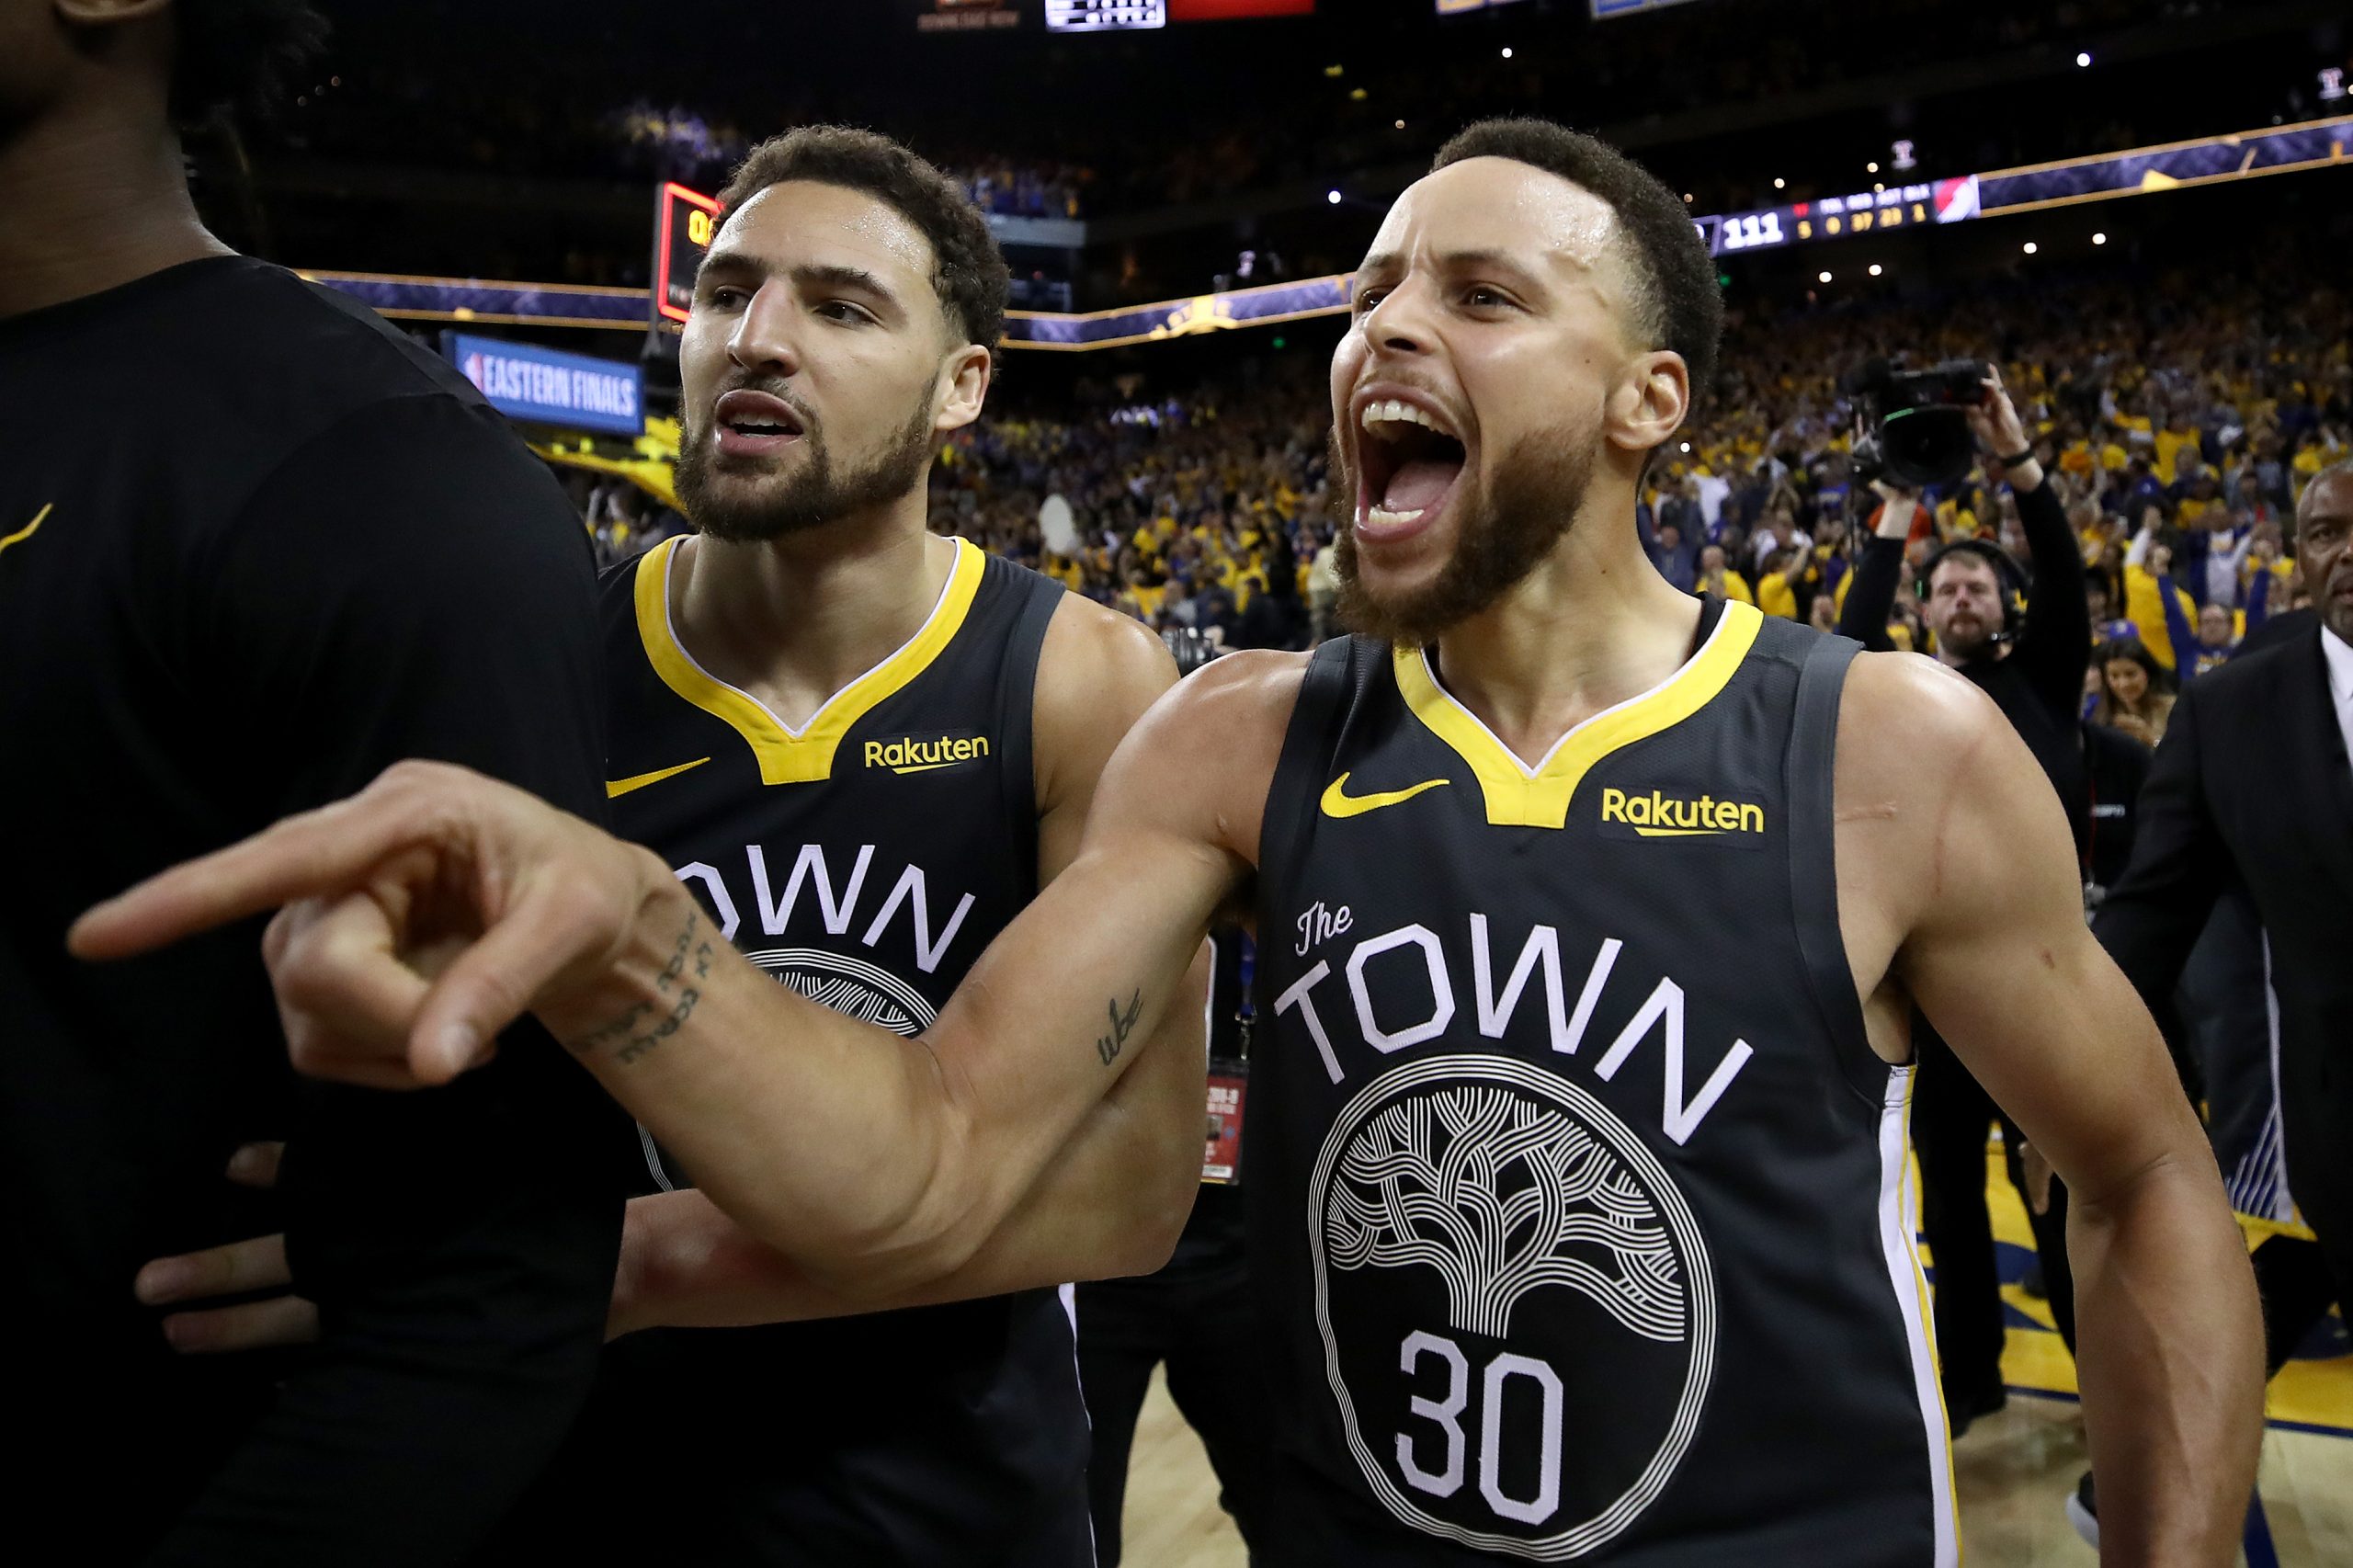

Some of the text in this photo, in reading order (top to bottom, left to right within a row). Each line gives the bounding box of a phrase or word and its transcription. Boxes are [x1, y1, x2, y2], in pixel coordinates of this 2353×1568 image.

[688, 210, 715, 247] 0
[1722, 211, 1784, 250] 111
[1913, 203, 1927, 222] 1
[483, 354, 636, 417] EASTERN FINALS
[864, 735, 990, 768] Rakuten
[1601, 788, 1765, 833] Rakuten
[1295, 901, 1354, 957] The
[1274, 913, 1755, 1147] TOWN
[1395, 1329, 1564, 1527] 30
